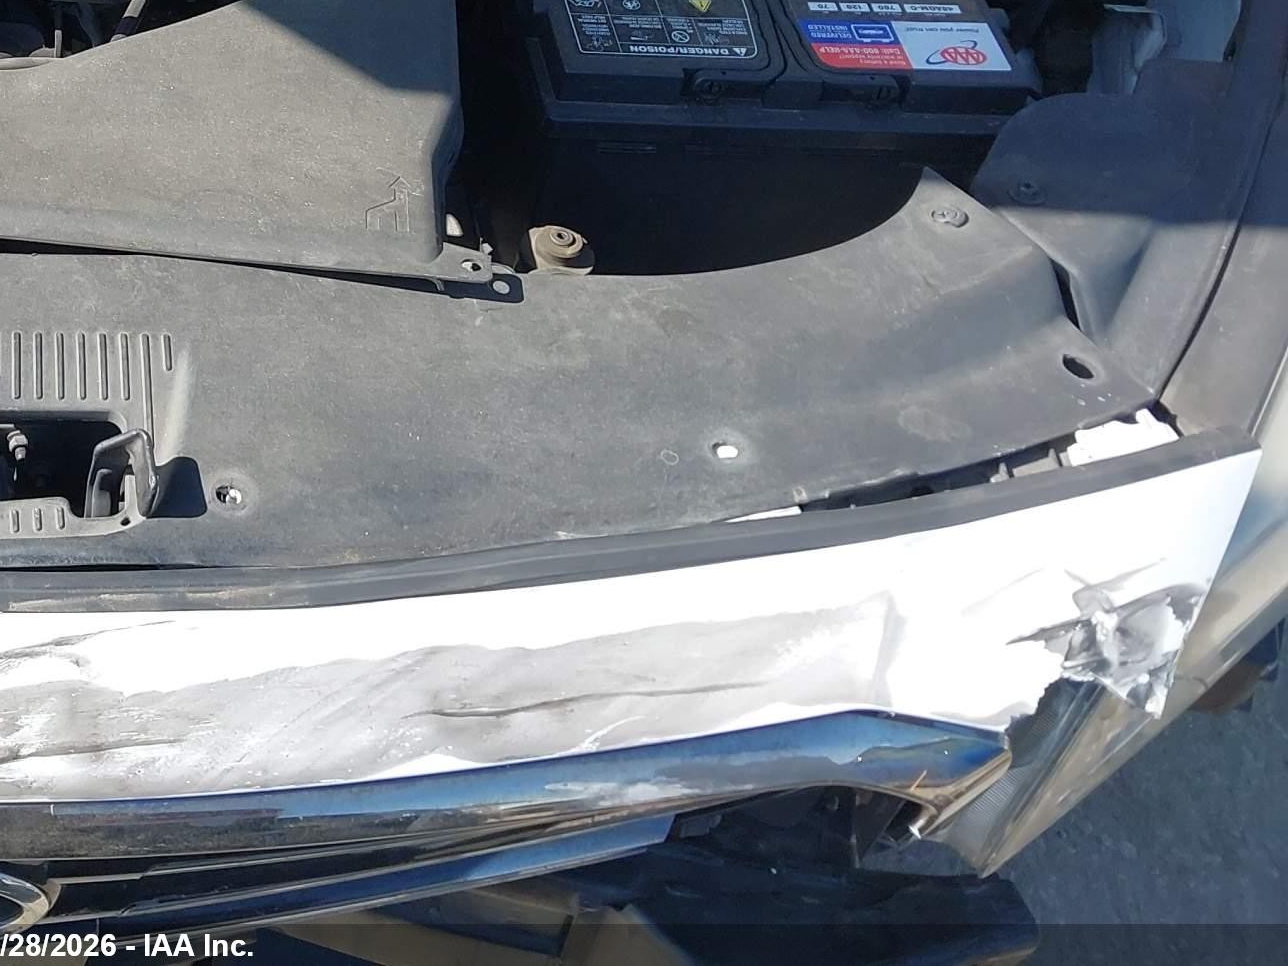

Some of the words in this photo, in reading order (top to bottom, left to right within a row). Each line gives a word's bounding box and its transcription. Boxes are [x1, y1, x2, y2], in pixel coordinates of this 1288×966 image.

[807, 24, 848, 32] INSTALLED
[629, 45, 730, 56] DANGER/POISON
[944, 47, 984, 65] AAA
